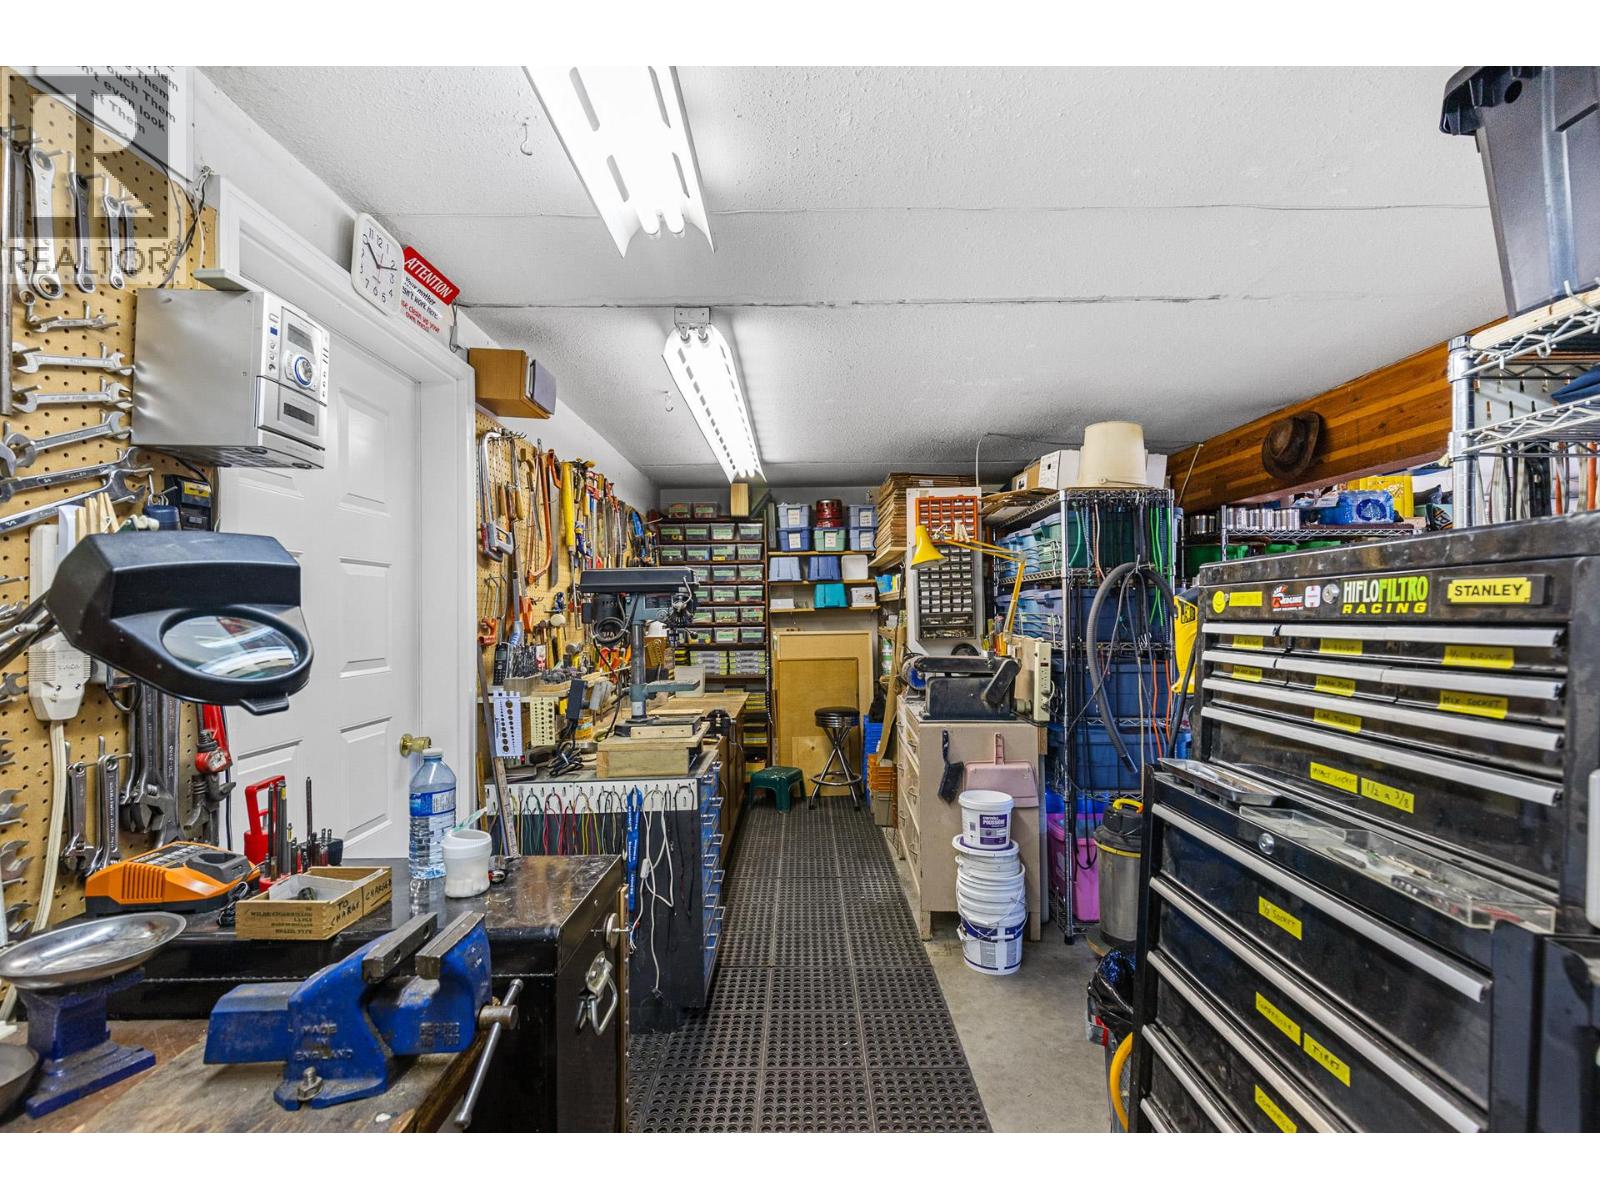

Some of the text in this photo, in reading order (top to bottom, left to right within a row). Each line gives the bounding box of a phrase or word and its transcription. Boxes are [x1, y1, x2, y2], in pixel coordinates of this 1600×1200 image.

[135, 67, 169, 101] Them
[103, 81, 135, 109] even
[139, 105, 165, 132] look
[108, 100, 145, 133] Them
[142, 89, 176, 122] Them
[404, 257, 454, 299] ATTENTION
[1454, 583, 1523, 597] STANLEY
[1342, 602, 1428, 615] RACING
[337, 899, 349, 911] TO
